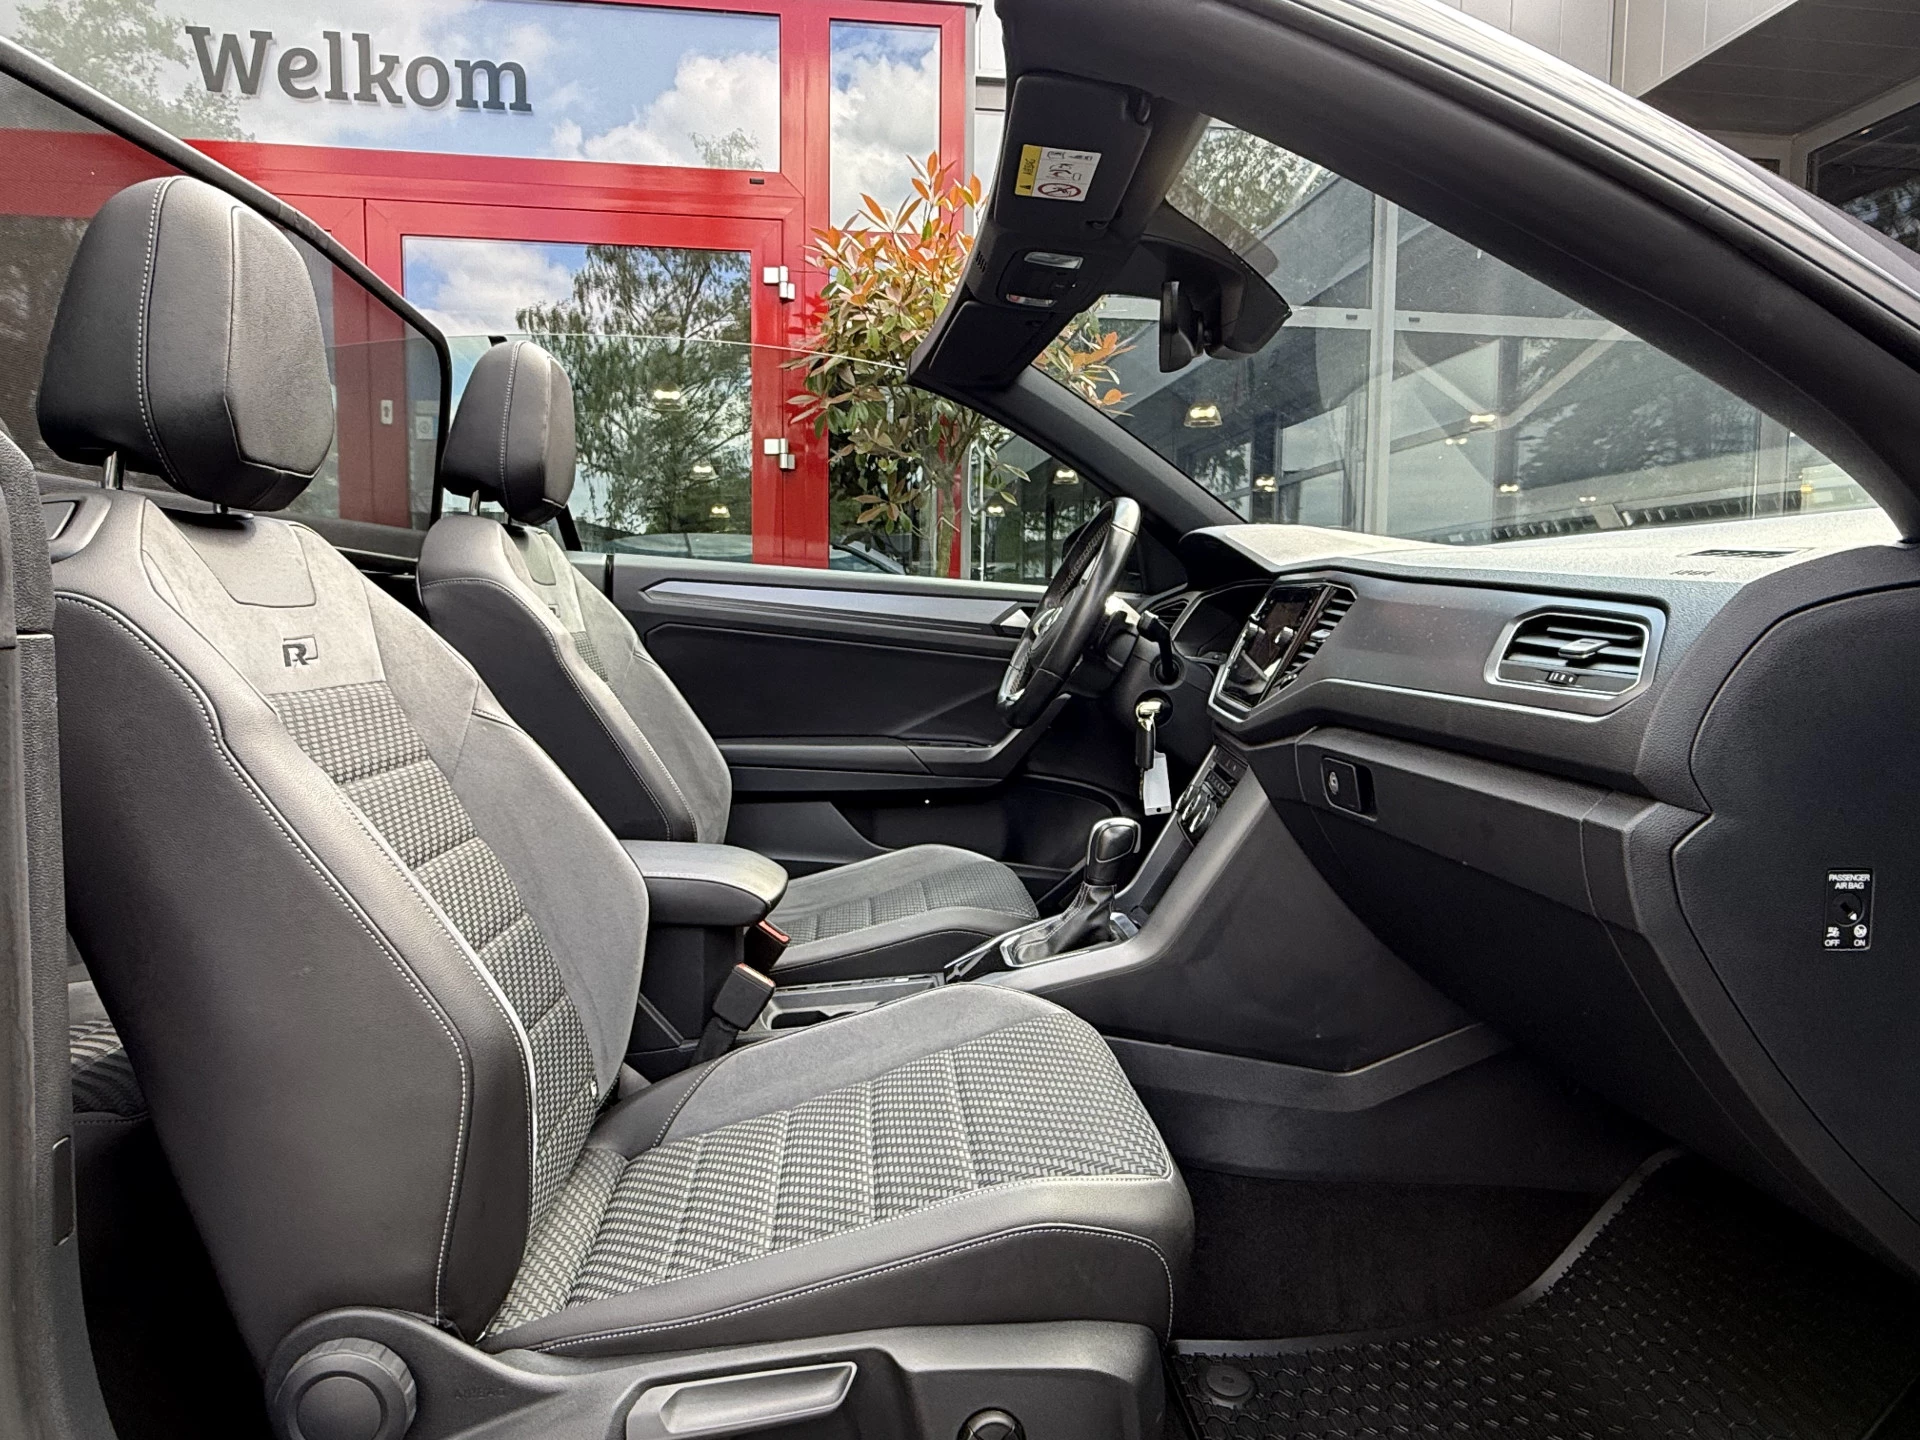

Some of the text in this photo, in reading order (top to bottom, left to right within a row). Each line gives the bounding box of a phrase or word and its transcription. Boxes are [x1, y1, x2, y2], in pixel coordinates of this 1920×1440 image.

[185, 26, 532, 112] Welkom
[282, 643, 310, 667] R
[1828, 874, 1870, 882] PASSENGER
[1824, 939, 1840, 947] OFF
[1853, 939, 1866, 947] ON
